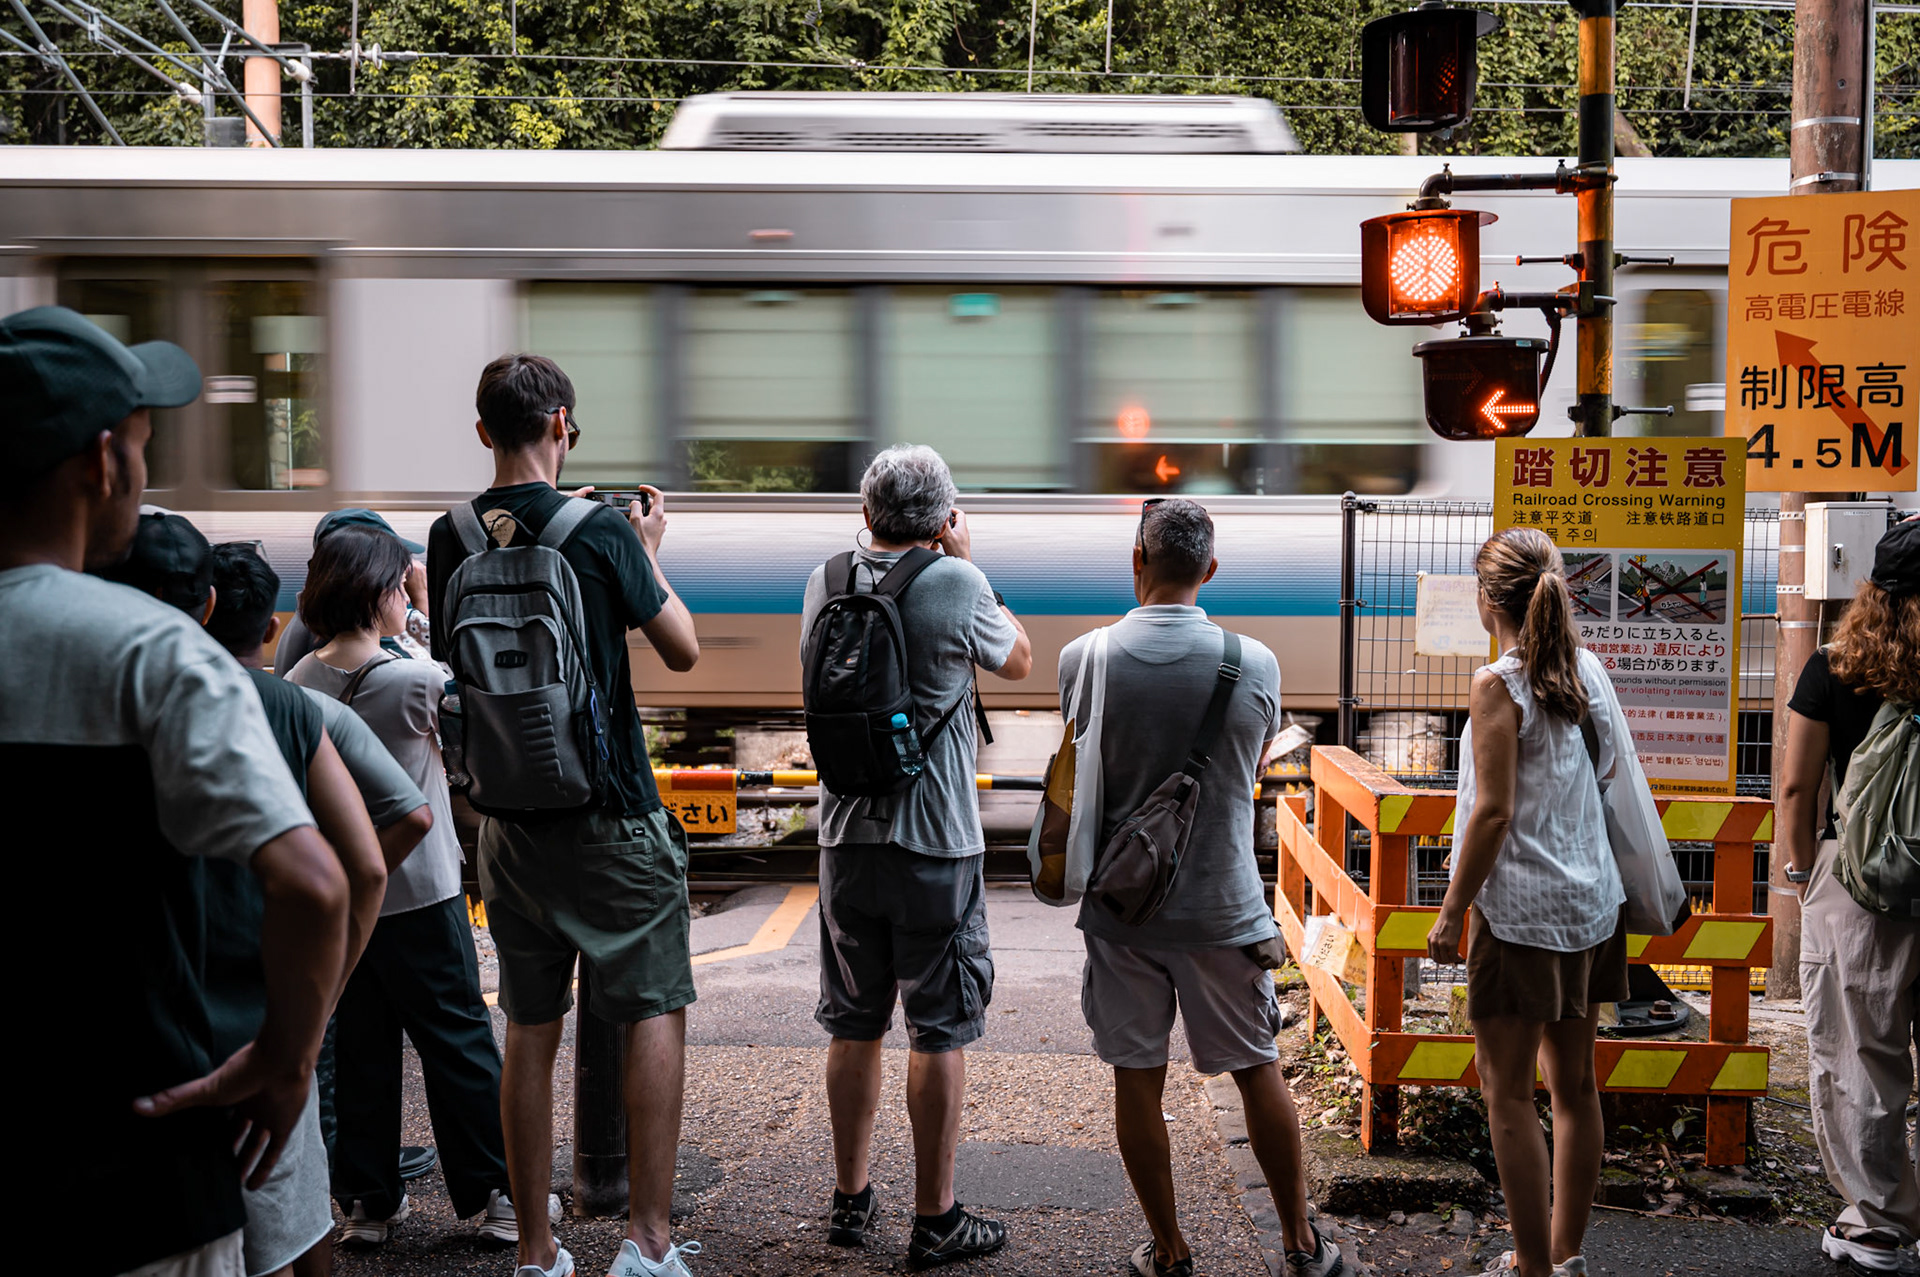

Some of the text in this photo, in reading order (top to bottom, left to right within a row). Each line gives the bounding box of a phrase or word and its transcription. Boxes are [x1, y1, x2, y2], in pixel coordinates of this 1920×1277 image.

[1745, 210, 1909, 277] 危険
[1745, 288, 1905, 322] 高電圧電線
[1740, 361, 1907, 411] 制限高
[1745, 422, 1903, 469] 4.5M
[1512, 446, 1727, 488] 踏切注意
[1513, 493, 1726, 509] Railroad Crossing Warning
[1513, 510, 1592, 525] 注意平交道
[1626, 511, 1725, 526] 注意铁路道口
[1566, 528, 1597, 543] 주의
[1581, 626, 1726, 642] みだりに立ち入ると、
[1599, 657, 1726, 674] る場合があります。
[1645, 676, 1676, 686] without
[1679, 679, 1726, 688] permission
[1631, 687, 1670, 697] violating
[1674, 688, 1706, 698] railway
[1709, 689, 1726, 697] law
[1631, 732, 1725, 744] 违反日本法律（铁道
